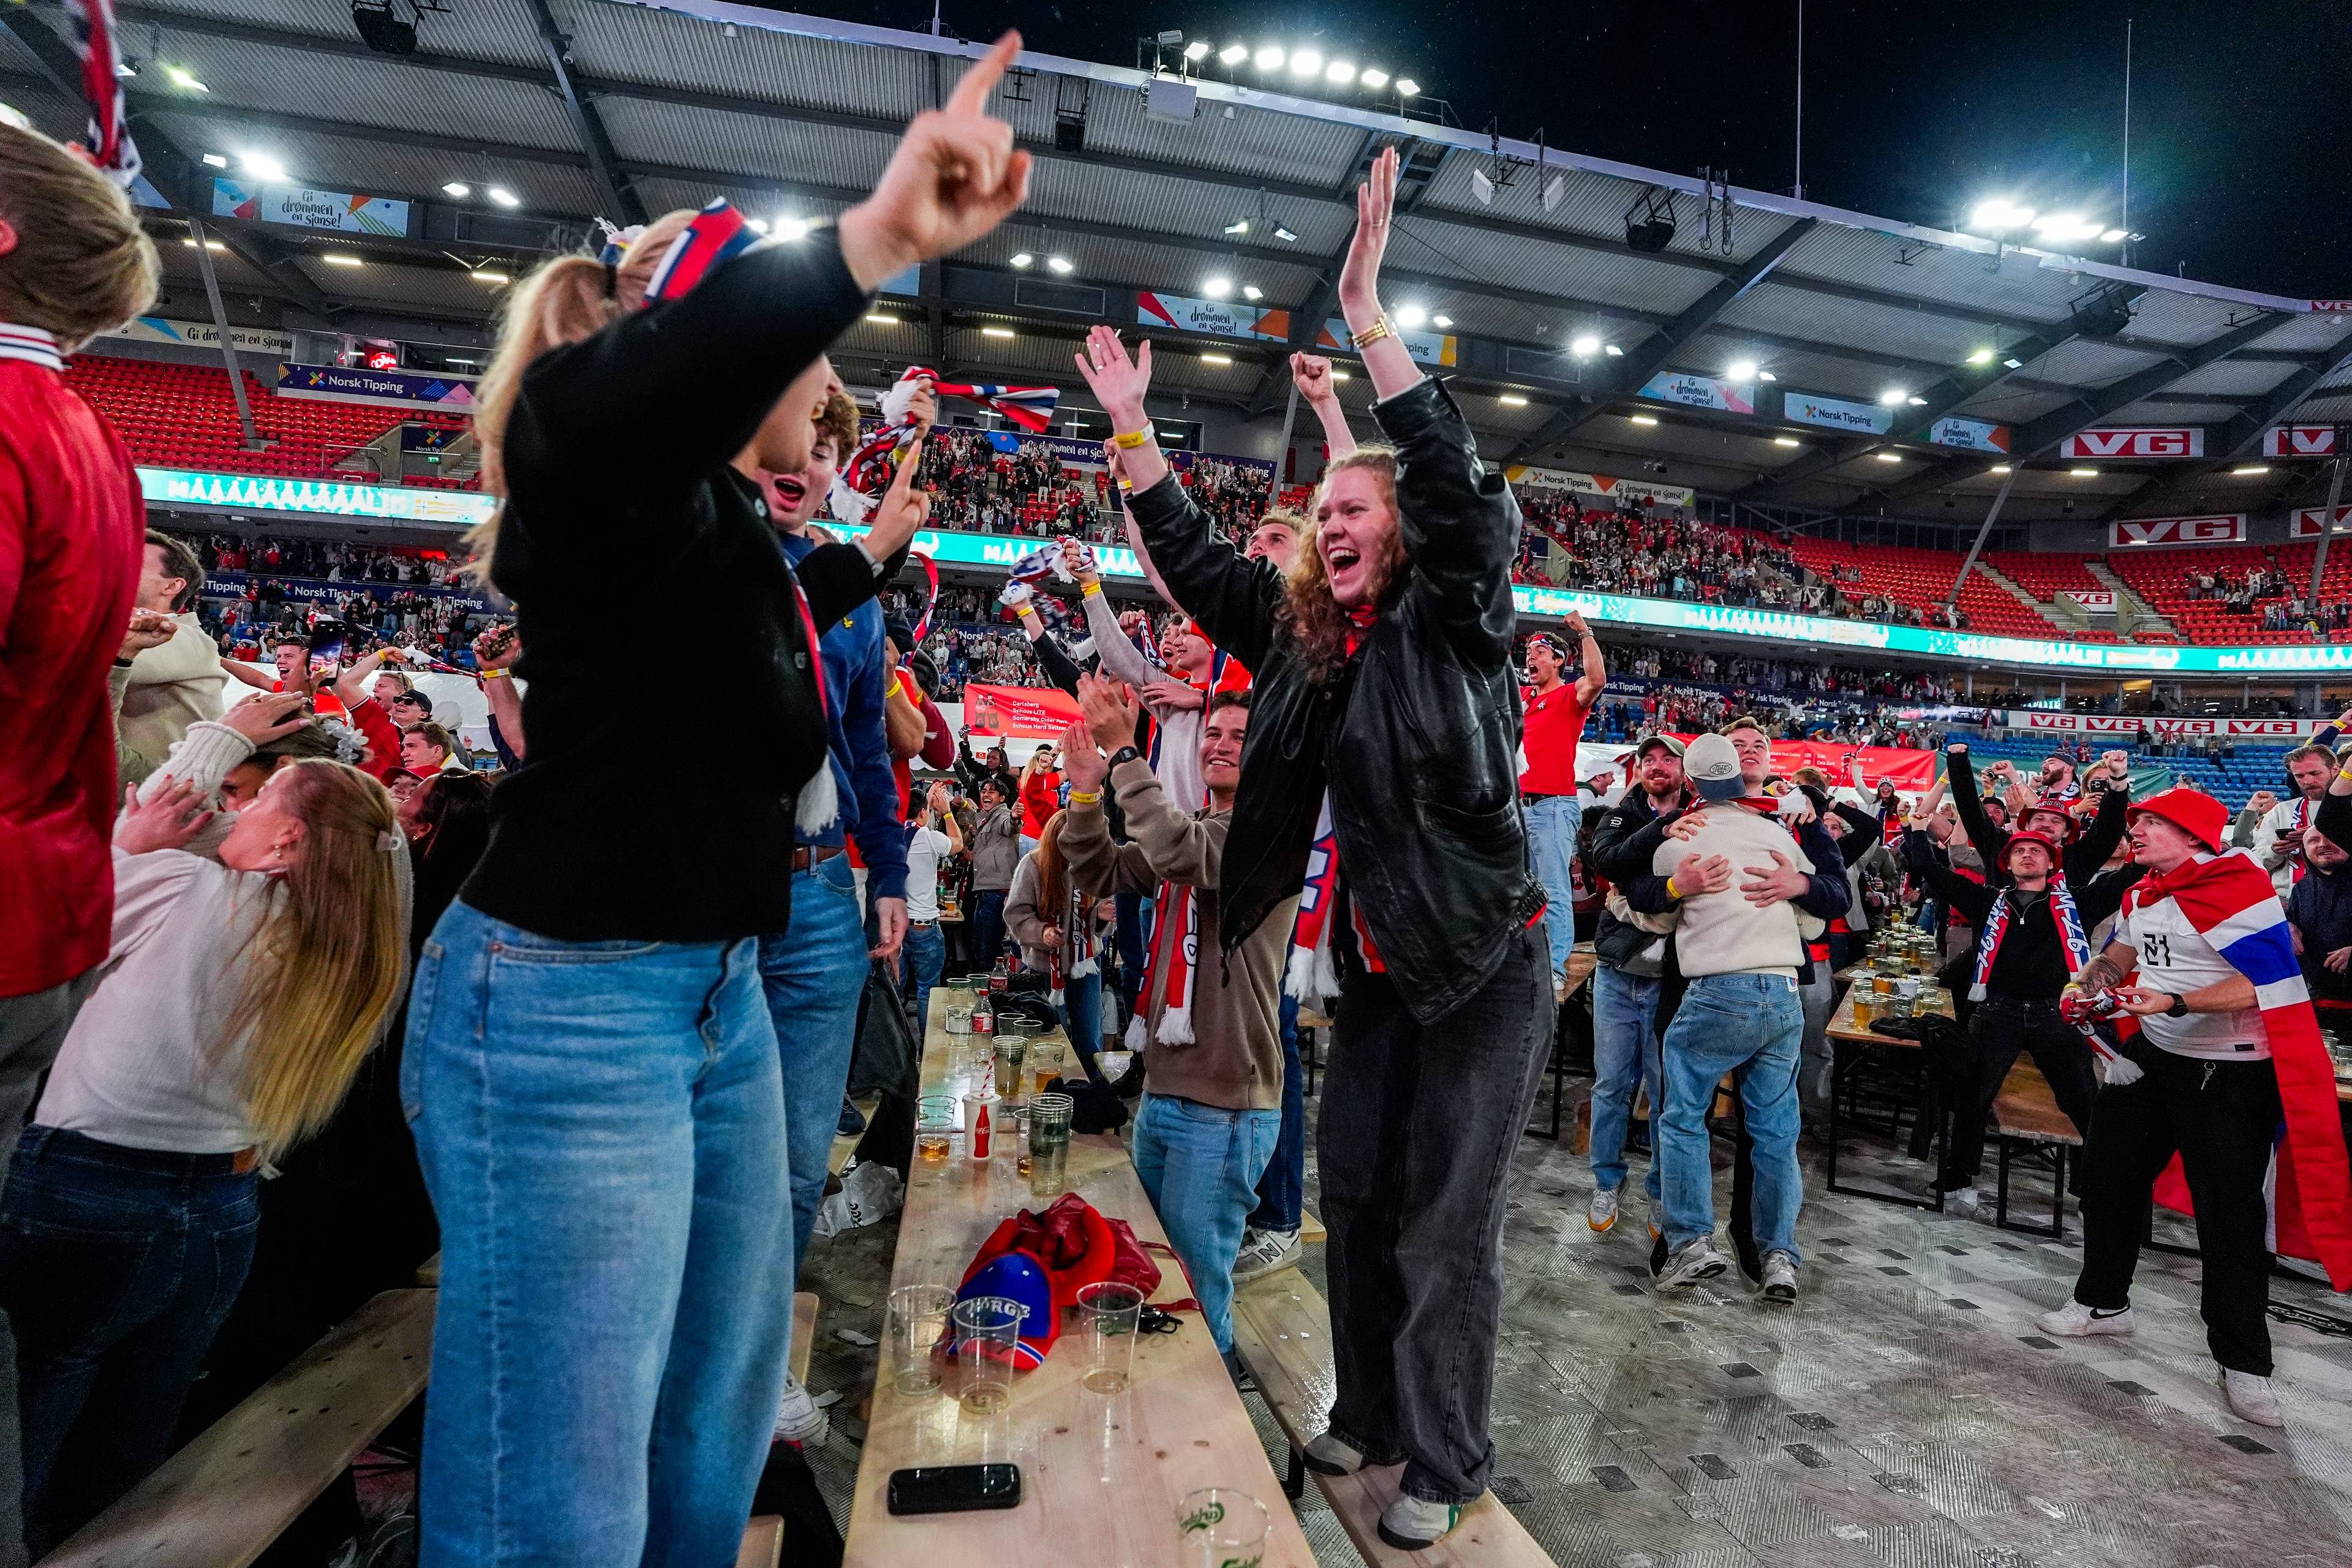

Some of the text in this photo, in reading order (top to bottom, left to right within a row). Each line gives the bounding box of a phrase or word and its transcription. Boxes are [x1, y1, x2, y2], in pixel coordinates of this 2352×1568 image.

[302, 191, 314, 202] Gi
[282, 195, 333, 216] drømmen
[292, 212, 341, 228] en sjanse!
[1206, 303, 1215, 312] Gi
[2313, 301, 2352, 311] VG
[1191, 306, 1231, 324] drømmen
[1208, 322, 1237, 335] sjanse!
[187, 327, 199, 341] Gi
[248, 335, 260, 344] en
[328, 374, 404, 394] Norsk Tipping
[1688, 377, 1696, 386] Gi
[1676, 380, 1708, 398] drømmen
[1691, 394, 1714, 407] sjanse!
[1819, 409, 1872, 427] Norsk Tipping
[1953, 420, 1960, 429] Gi
[1943, 423, 1971, 440] drømmen
[1955, 436, 1975, 448] sjanse!
[2077, 432, 2185, 455] VG
[1078, 447, 1089, 456] en
[1544, 475, 1593, 491] Norsk Tipping
[1616, 483, 1624, 493] Gi
[1662, 489, 1685, 502] sjanse!
[2120, 518, 2231, 542] VG
[206, 580, 246, 594] Tipping
[295, 586, 325, 597] Norsk
[2067, 593, 2109, 604] VG
[1619, 682, 1645, 693] Tipping
[1887, 704, 1905, 714] Norsk
[2032, 715, 2076, 728] VG
[2087, 718, 2142, 731] VG
[2157, 721, 2211, 733] VG
[2231, 722, 2294, 734] VG
